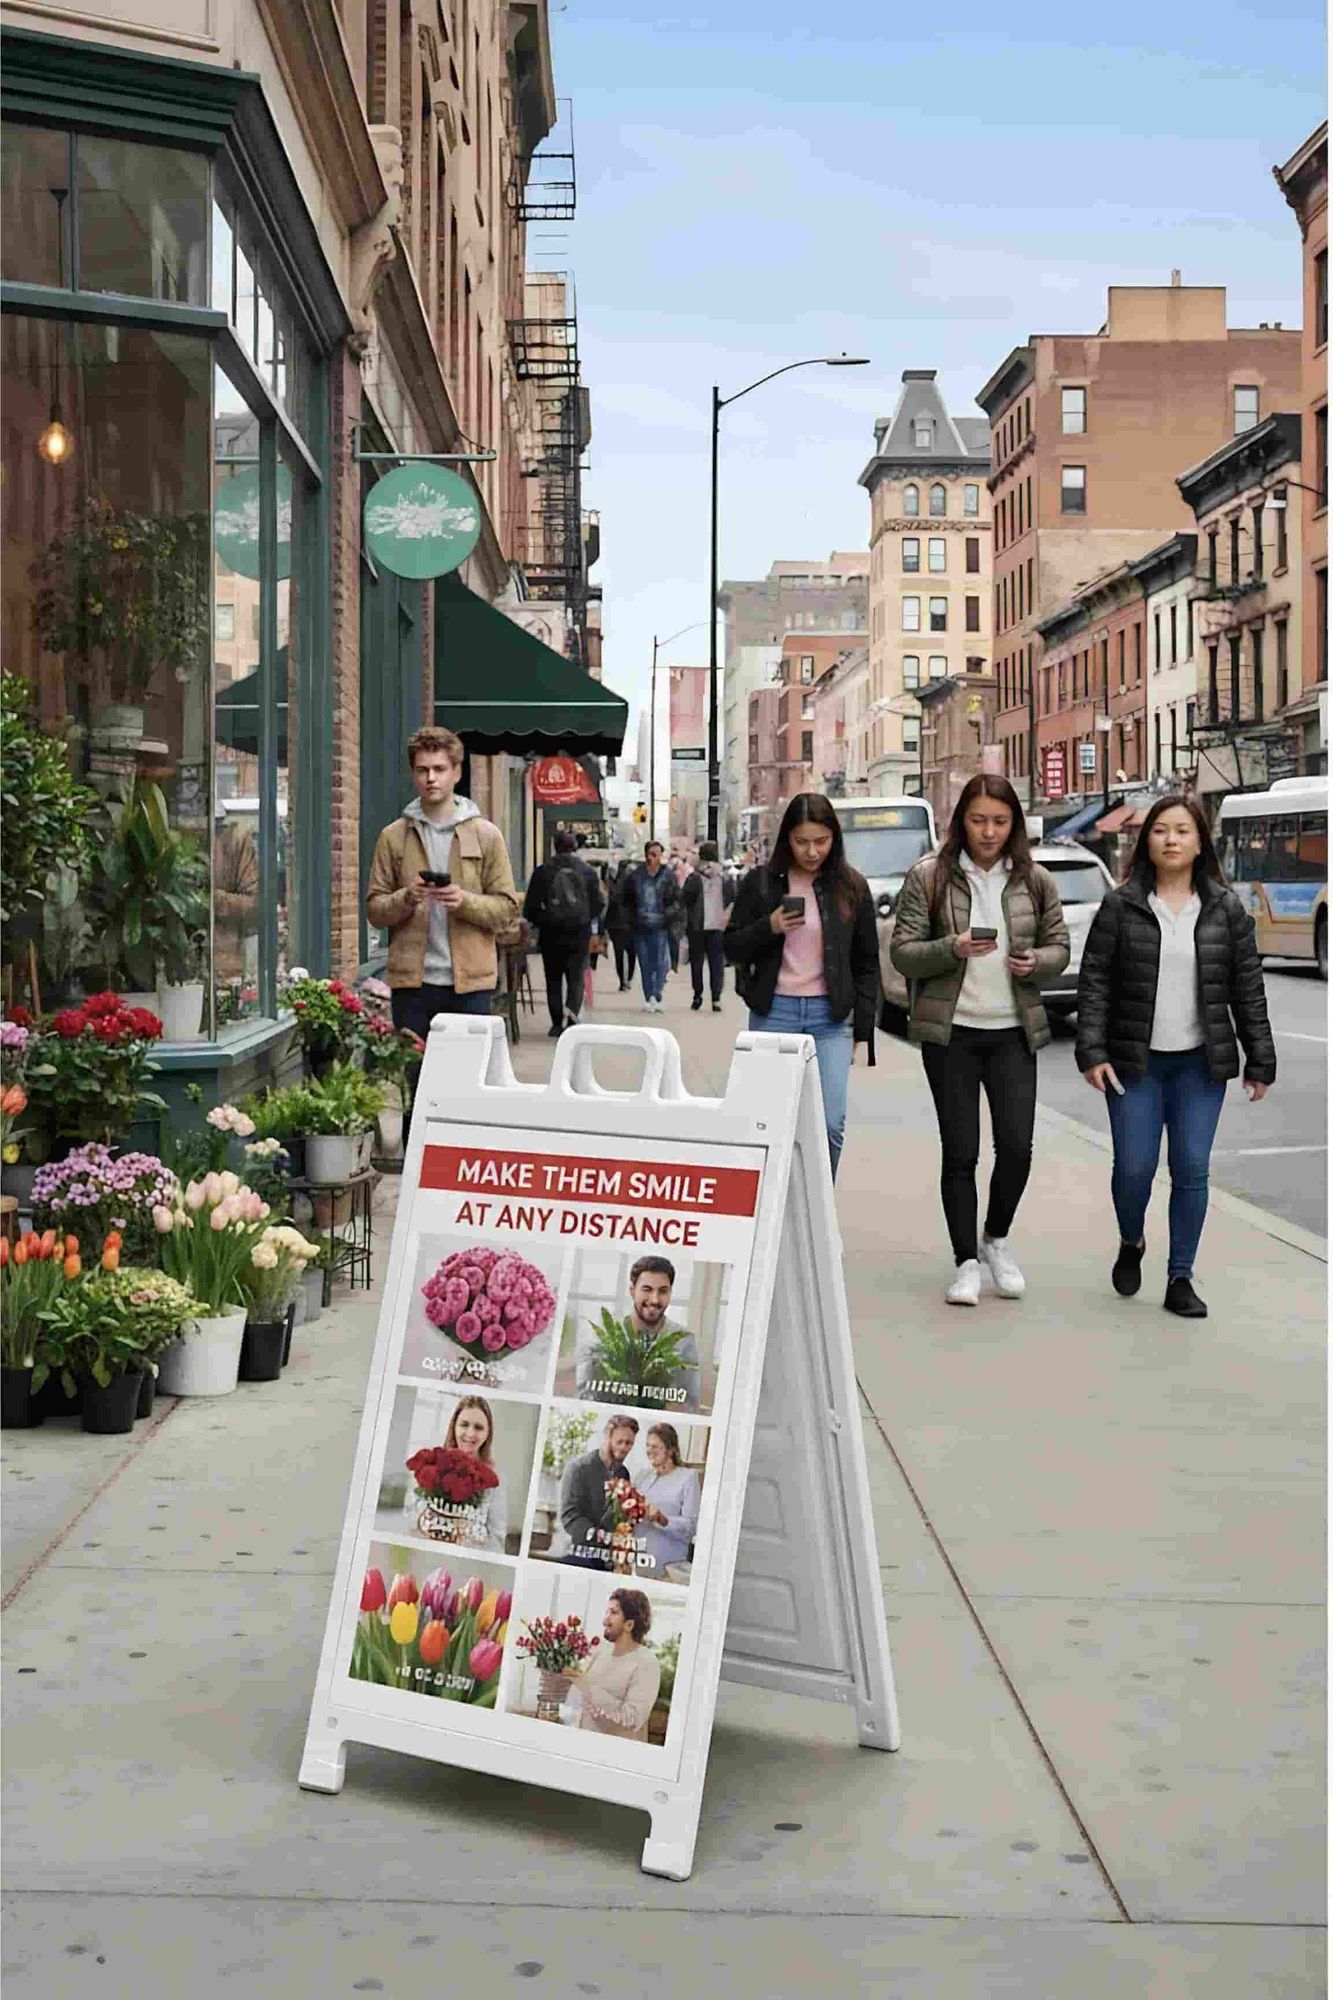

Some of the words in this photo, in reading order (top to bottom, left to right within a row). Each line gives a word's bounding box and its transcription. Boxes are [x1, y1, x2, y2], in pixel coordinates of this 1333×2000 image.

[457, 1159, 534, 1188] MAKE
[543, 1166, 621, 1196] THEM
[629, 1173, 717, 1204] SMILE
[456, 1201, 492, 1226] AT
[496, 1205, 553, 1232] ANY
[560, 1211, 701, 1246] DISTANCE
